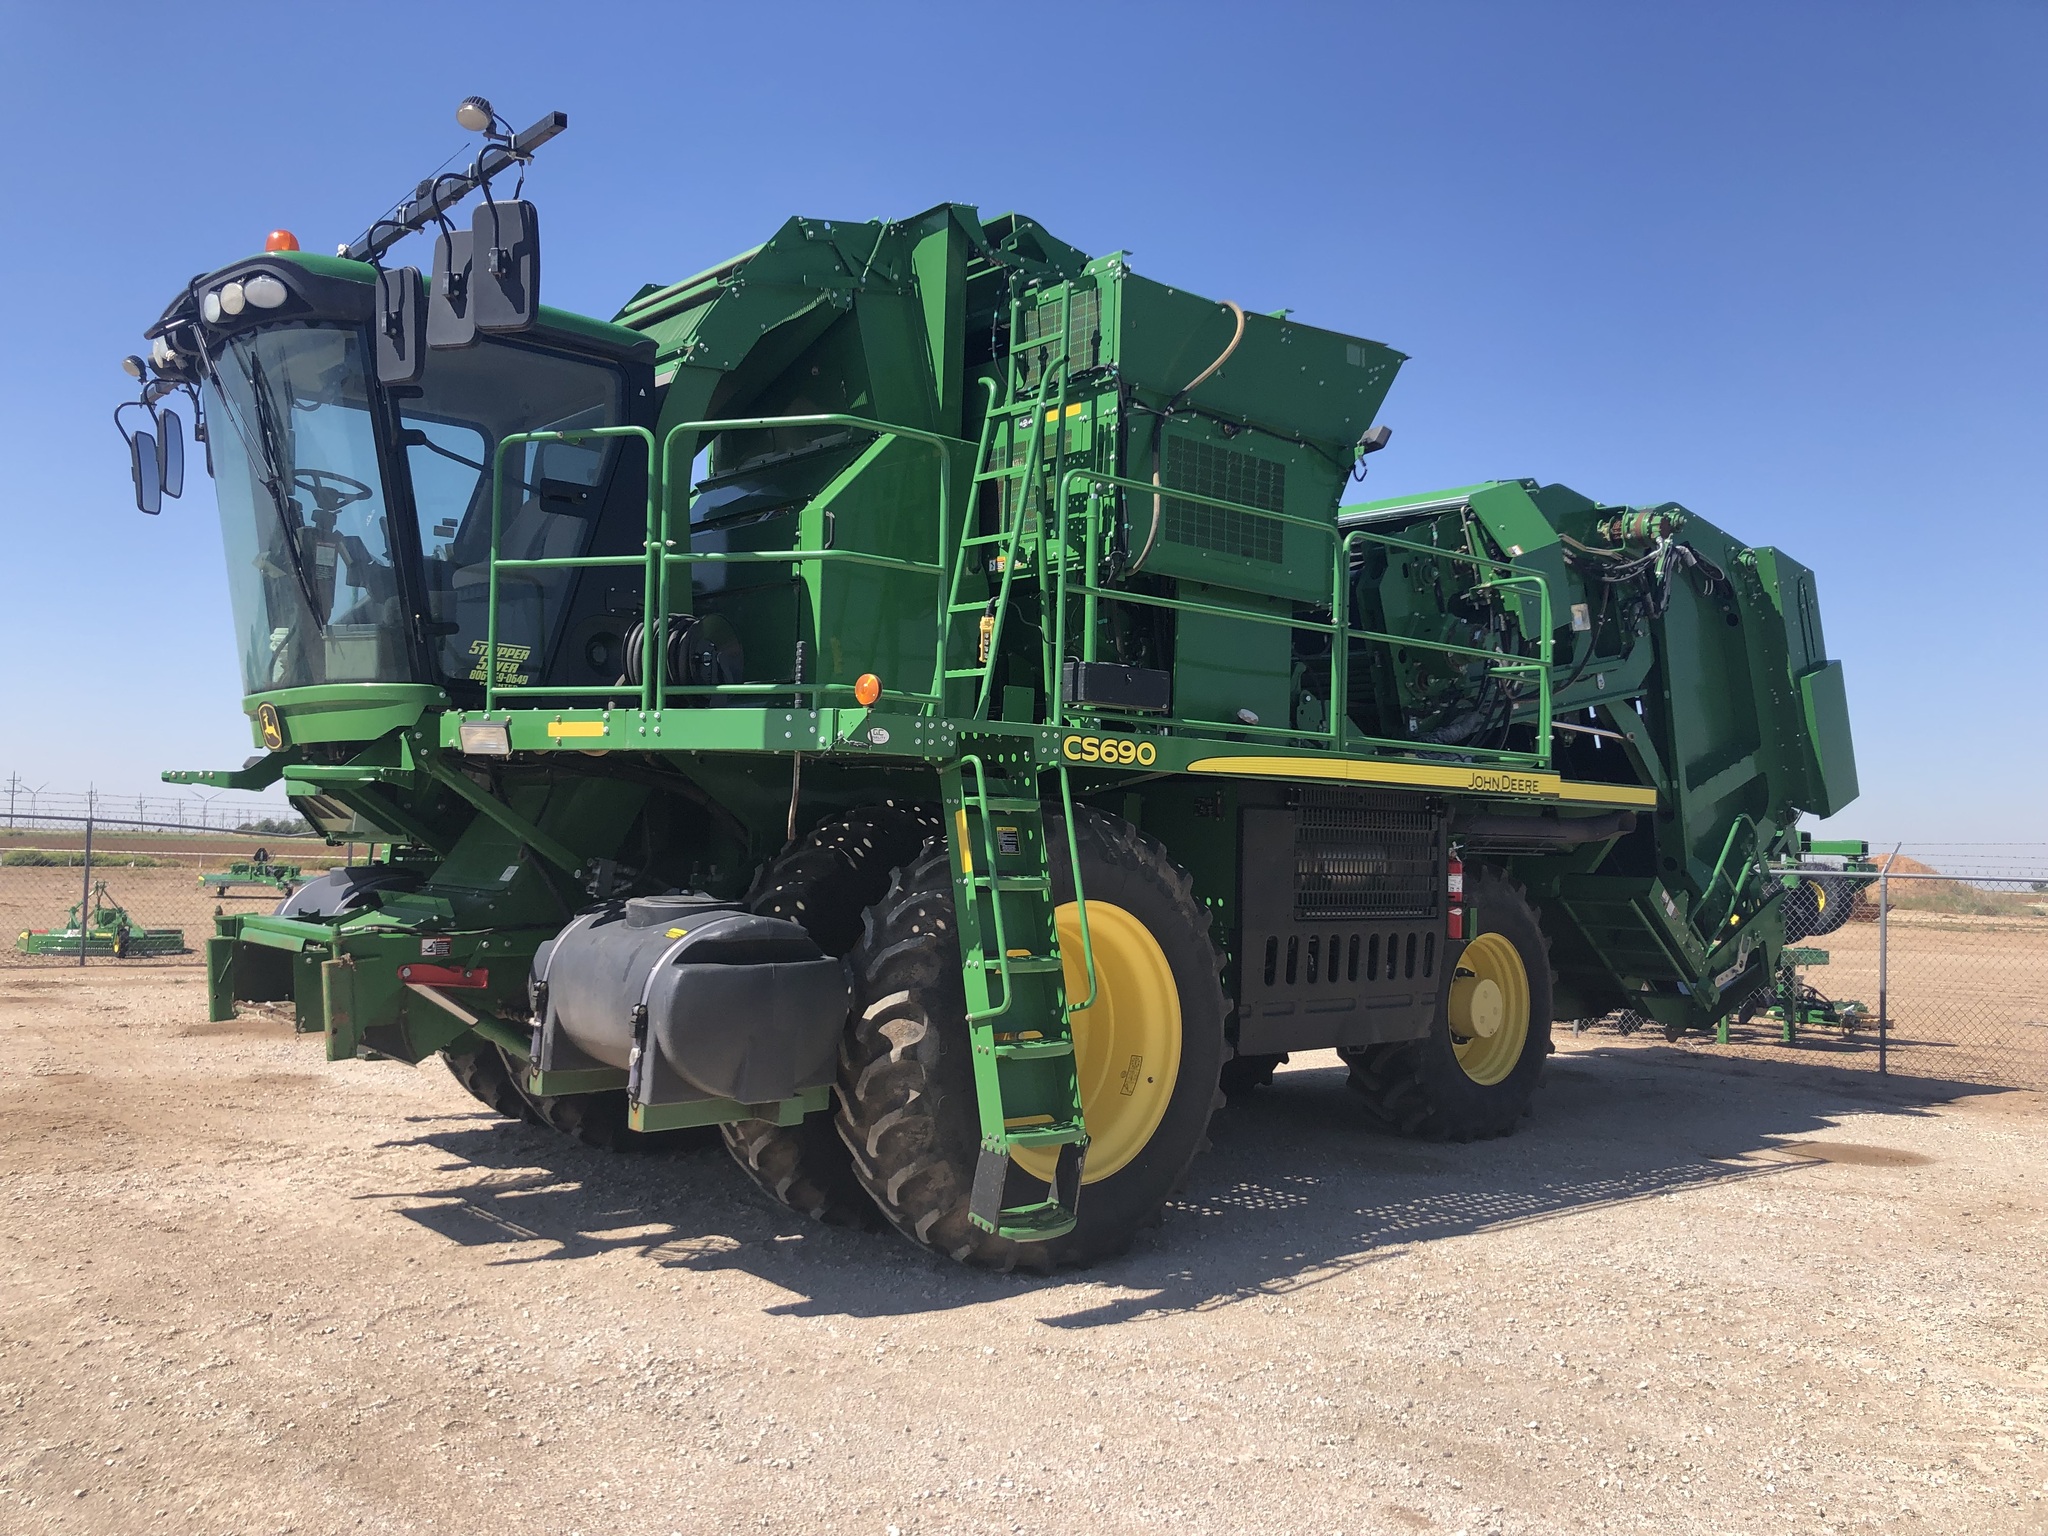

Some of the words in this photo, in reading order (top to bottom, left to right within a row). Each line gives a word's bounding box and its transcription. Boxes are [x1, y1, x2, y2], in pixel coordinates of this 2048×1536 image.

[468, 640, 531, 660] STPPER
[476, 656, 521, 673] SVER
[469, 669, 529, 685] 806-9-0649
[1062, 734, 1157, 766] CS690
[1468, 772, 1500, 789] JOHN
[1501, 775, 1540, 792] DEERE
